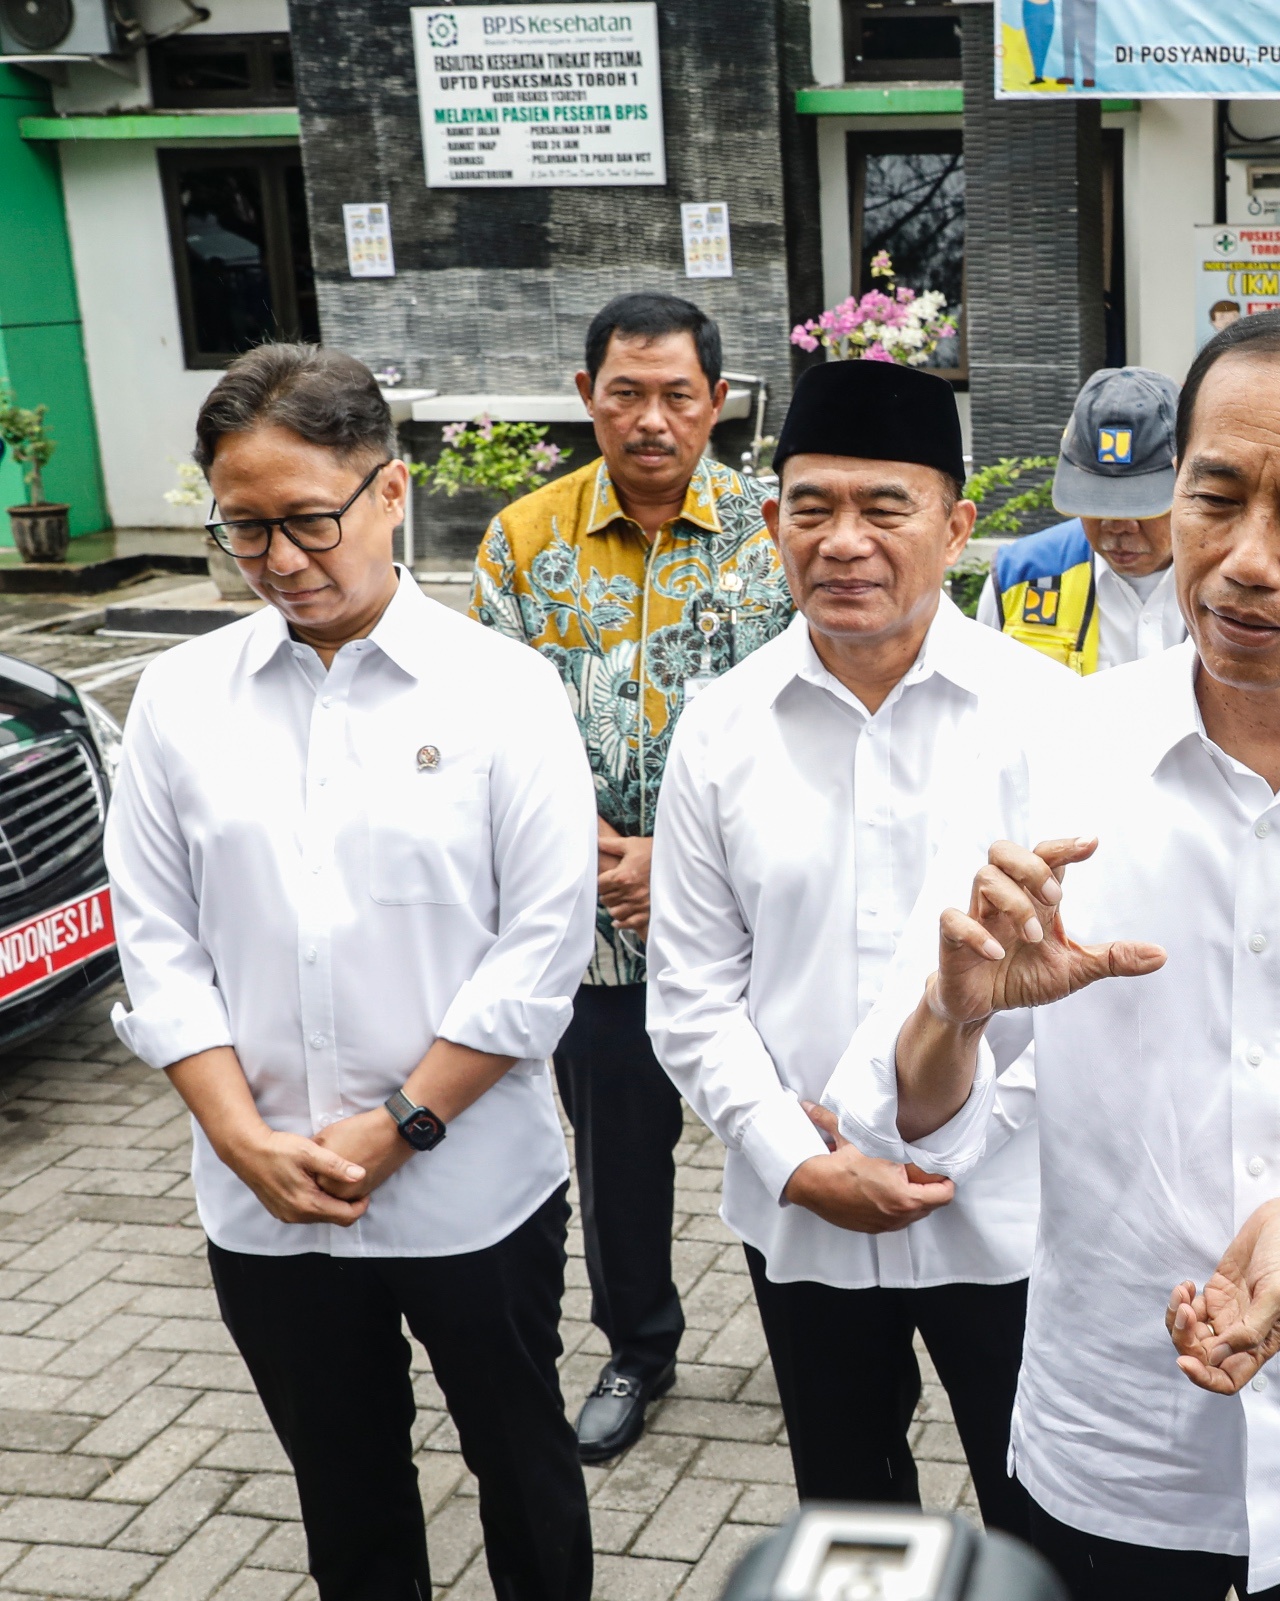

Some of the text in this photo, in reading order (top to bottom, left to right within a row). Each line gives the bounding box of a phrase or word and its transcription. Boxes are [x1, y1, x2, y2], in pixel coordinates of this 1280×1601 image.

[482, 14, 632, 35] BPJS Kesehatan
[434, 50, 643, 72] FASILITAS KESEHATAN TINGKAT PERTAMA
[1115, 46, 1133, 63] DI
[1141, 45, 1250, 67] POSYANDU,
[440, 72, 638, 90] UPTD PUSKESMAS TOROH 1
[434, 104, 649, 124] MELAYANI PASIEN PESERTA BPJS
